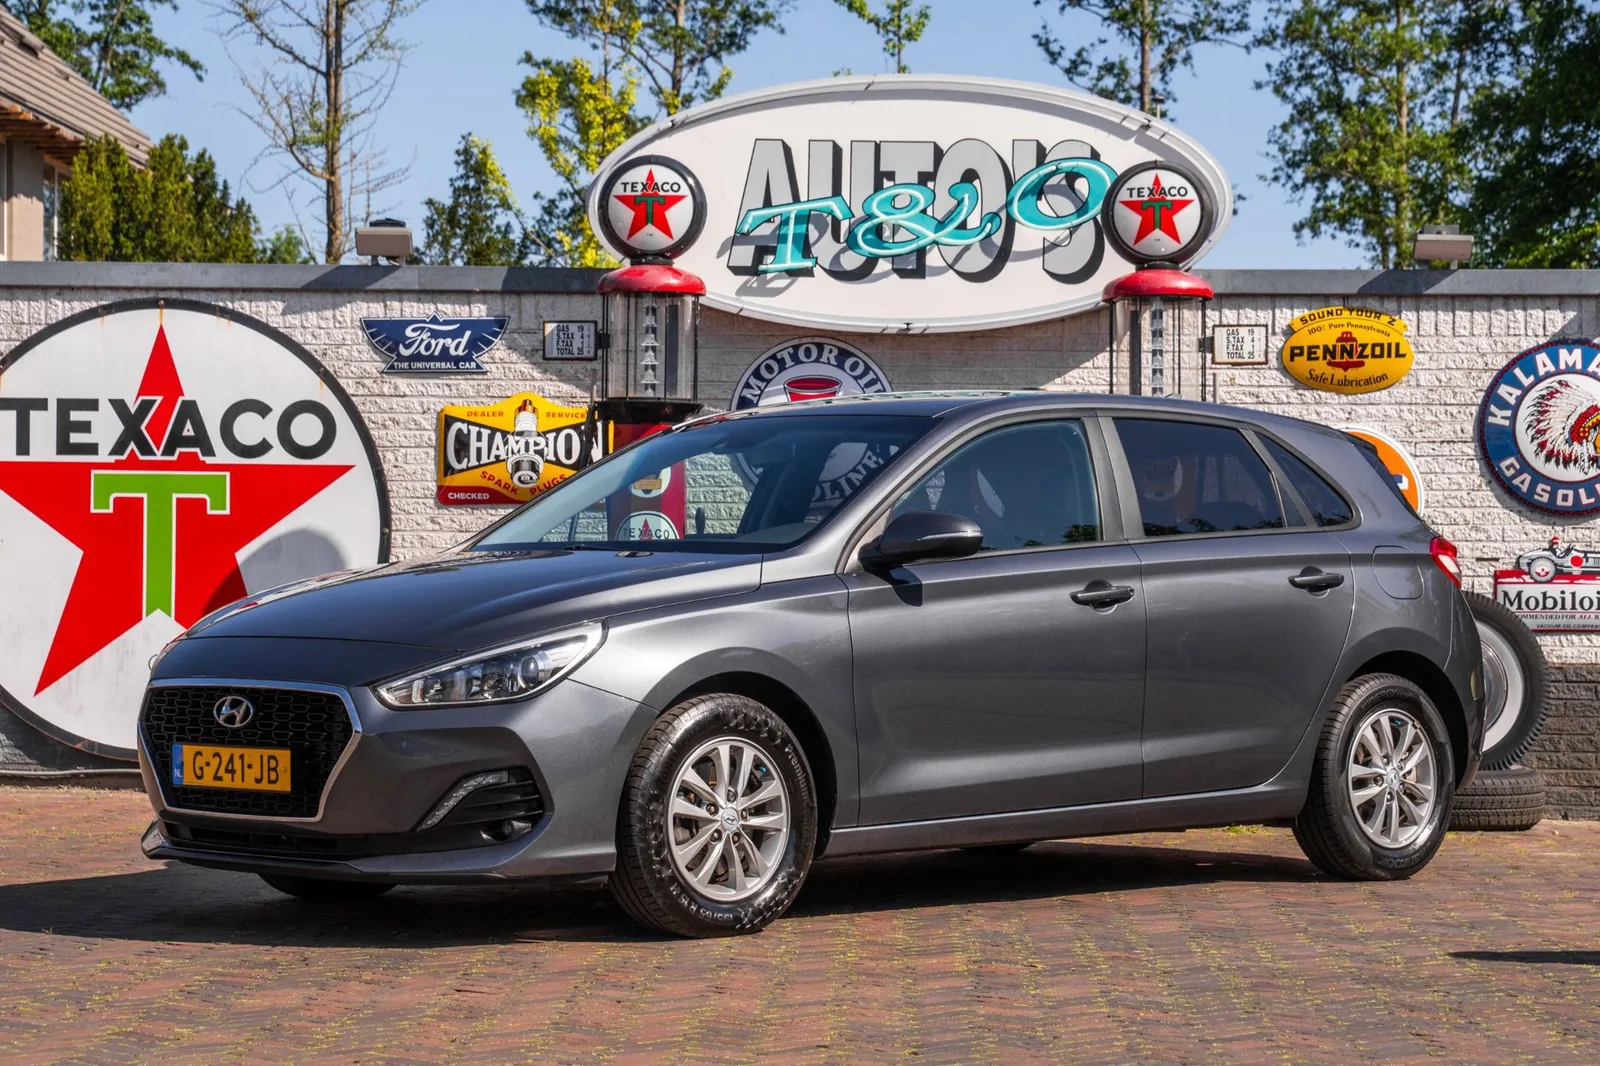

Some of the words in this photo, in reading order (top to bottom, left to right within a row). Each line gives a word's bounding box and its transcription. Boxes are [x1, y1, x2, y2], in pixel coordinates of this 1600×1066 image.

[620, 181, 681, 193] TEXACO
[1126, 186, 1188, 198] TEXACO
[1299, 308, 1343, 325] SOUND
[1346, 307, 1382, 320] YOUR
[1387, 316, 1397, 326] Z
[556, 324, 570, 333] GAS
[577, 324, 585, 333] 19
[1226, 328, 1240, 336] GAS
[1248, 328, 1255, 336] 19
[1328, 322, 1346, 330] Pure
[1346, 322, 1391, 337] Pennsylvania
[398, 323, 472, 357] Ford
[556, 332, 575, 340] S.TAX
[1226, 336, 1245, 344] S.TAX
[556, 347, 575, 356] TOTAL
[577, 347, 585, 356] 25
[1226, 351, 1245, 360] TOTAL
[1248, 351, 1255, 360] 25
[1289, 342, 1407, 362] PENNZOIL
[393, 361, 410, 370] THE
[410, 361, 457, 370] UNIVERSAL
[459, 361, 477, 370] CAR
[741, 343, 839, 405] MOTOR
[1306, 368, 1329, 384] Safe
[1329, 373, 1389, 388] Lubrication
[545, 411, 587, 419] SERVICE
[0, 397, 338, 460] TEXACO
[446, 419, 604, 470] CHAMPION
[480, 470, 520, 495] SPARK
[529, 473, 568, 496] PLUGS
[448, 492, 490, 500] CHECKED
[623, 527, 670, 539] TEXACO
[174, 768, 183, 778] NL
[192, 750, 280, 785] G-241-JB
